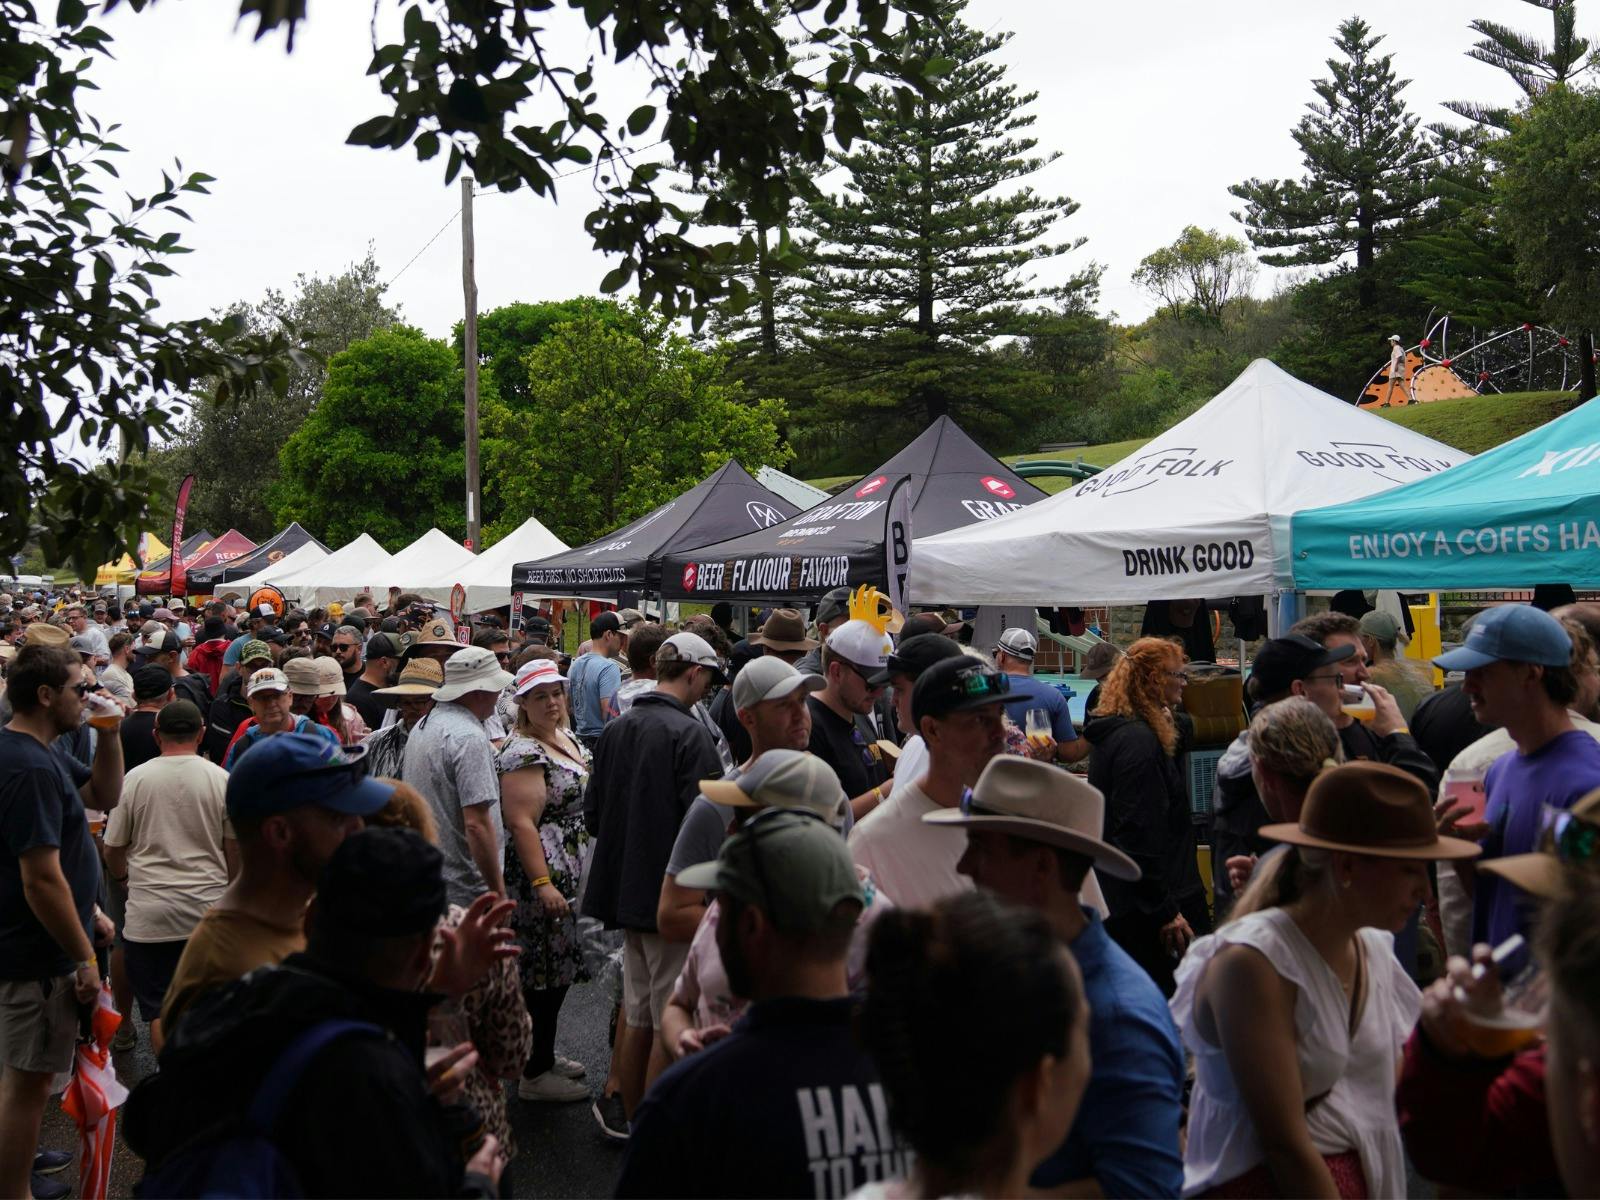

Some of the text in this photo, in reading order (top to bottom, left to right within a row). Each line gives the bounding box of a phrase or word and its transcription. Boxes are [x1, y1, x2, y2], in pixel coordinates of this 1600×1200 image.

[1075, 457, 1235, 498] GOOD FOLK
[1296, 449, 1387, 470] GOOD
[792, 500, 888, 526] GRAFTON
[961, 499, 1027, 520] GRAF
[1122, 539, 1255, 577] DRINK GOOD
[1349, 520, 1600, 560] ENJOY A COFFS HA
[526, 570, 544, 583] BEER
[565, 569, 577, 583] NO
[577, 567, 626, 583] SHORTCUTS
[696, 563, 724, 591] BEER
[731, 557, 791, 592] FLAVOUR
[799, 555, 849, 588] FAVOUR
[808, 1156, 855, 1200] TO
